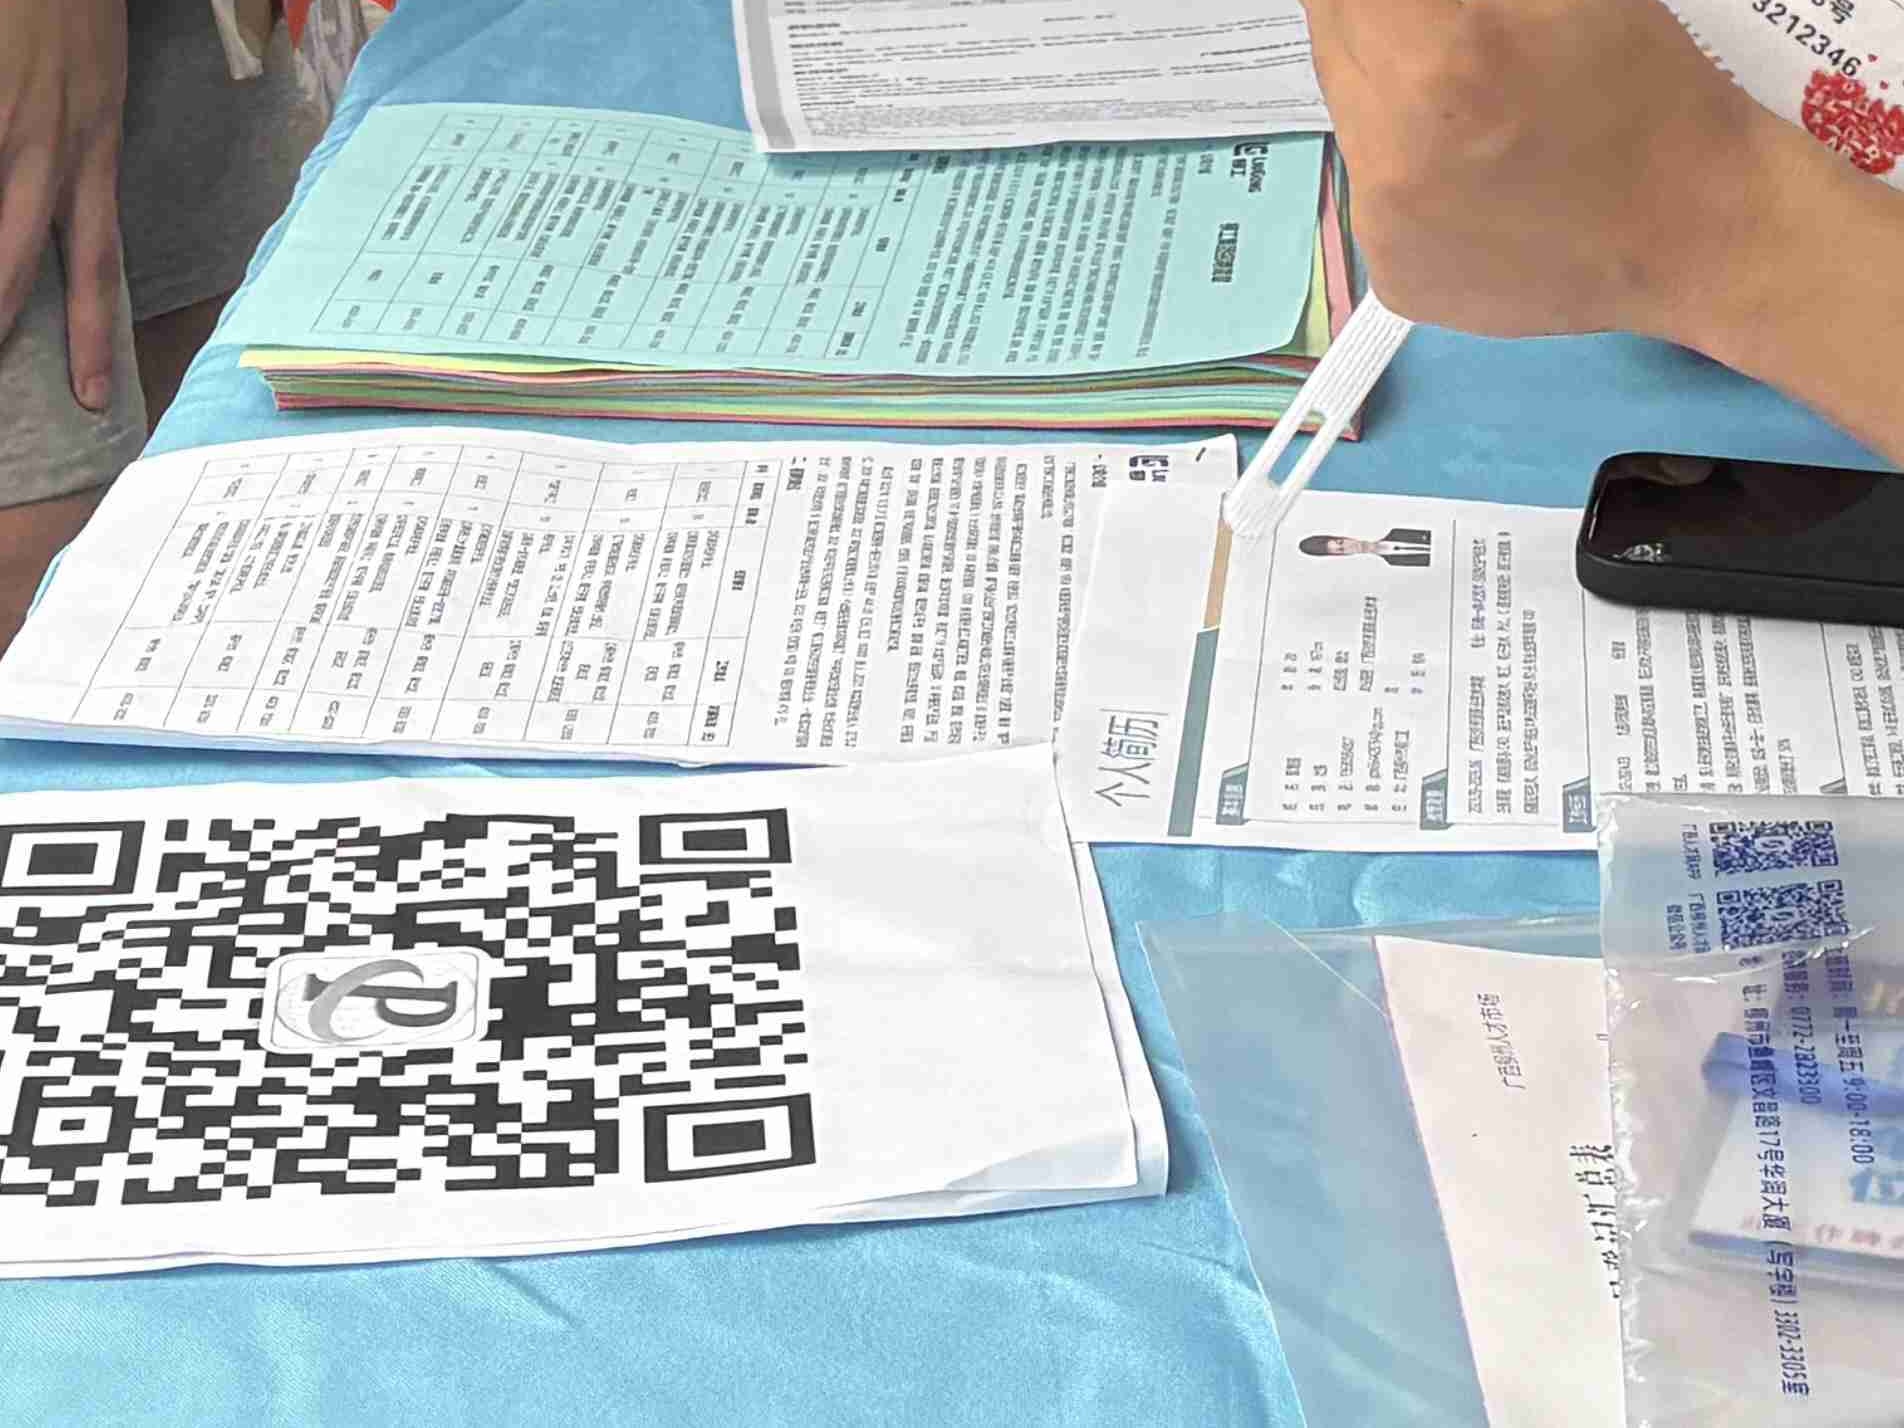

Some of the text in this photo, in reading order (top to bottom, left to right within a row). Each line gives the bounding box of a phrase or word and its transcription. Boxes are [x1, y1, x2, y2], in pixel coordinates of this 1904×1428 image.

[1094, 713, 1162, 808] 个人简历
[1840, 1075, 1876, 1165] 9:00-18:00
